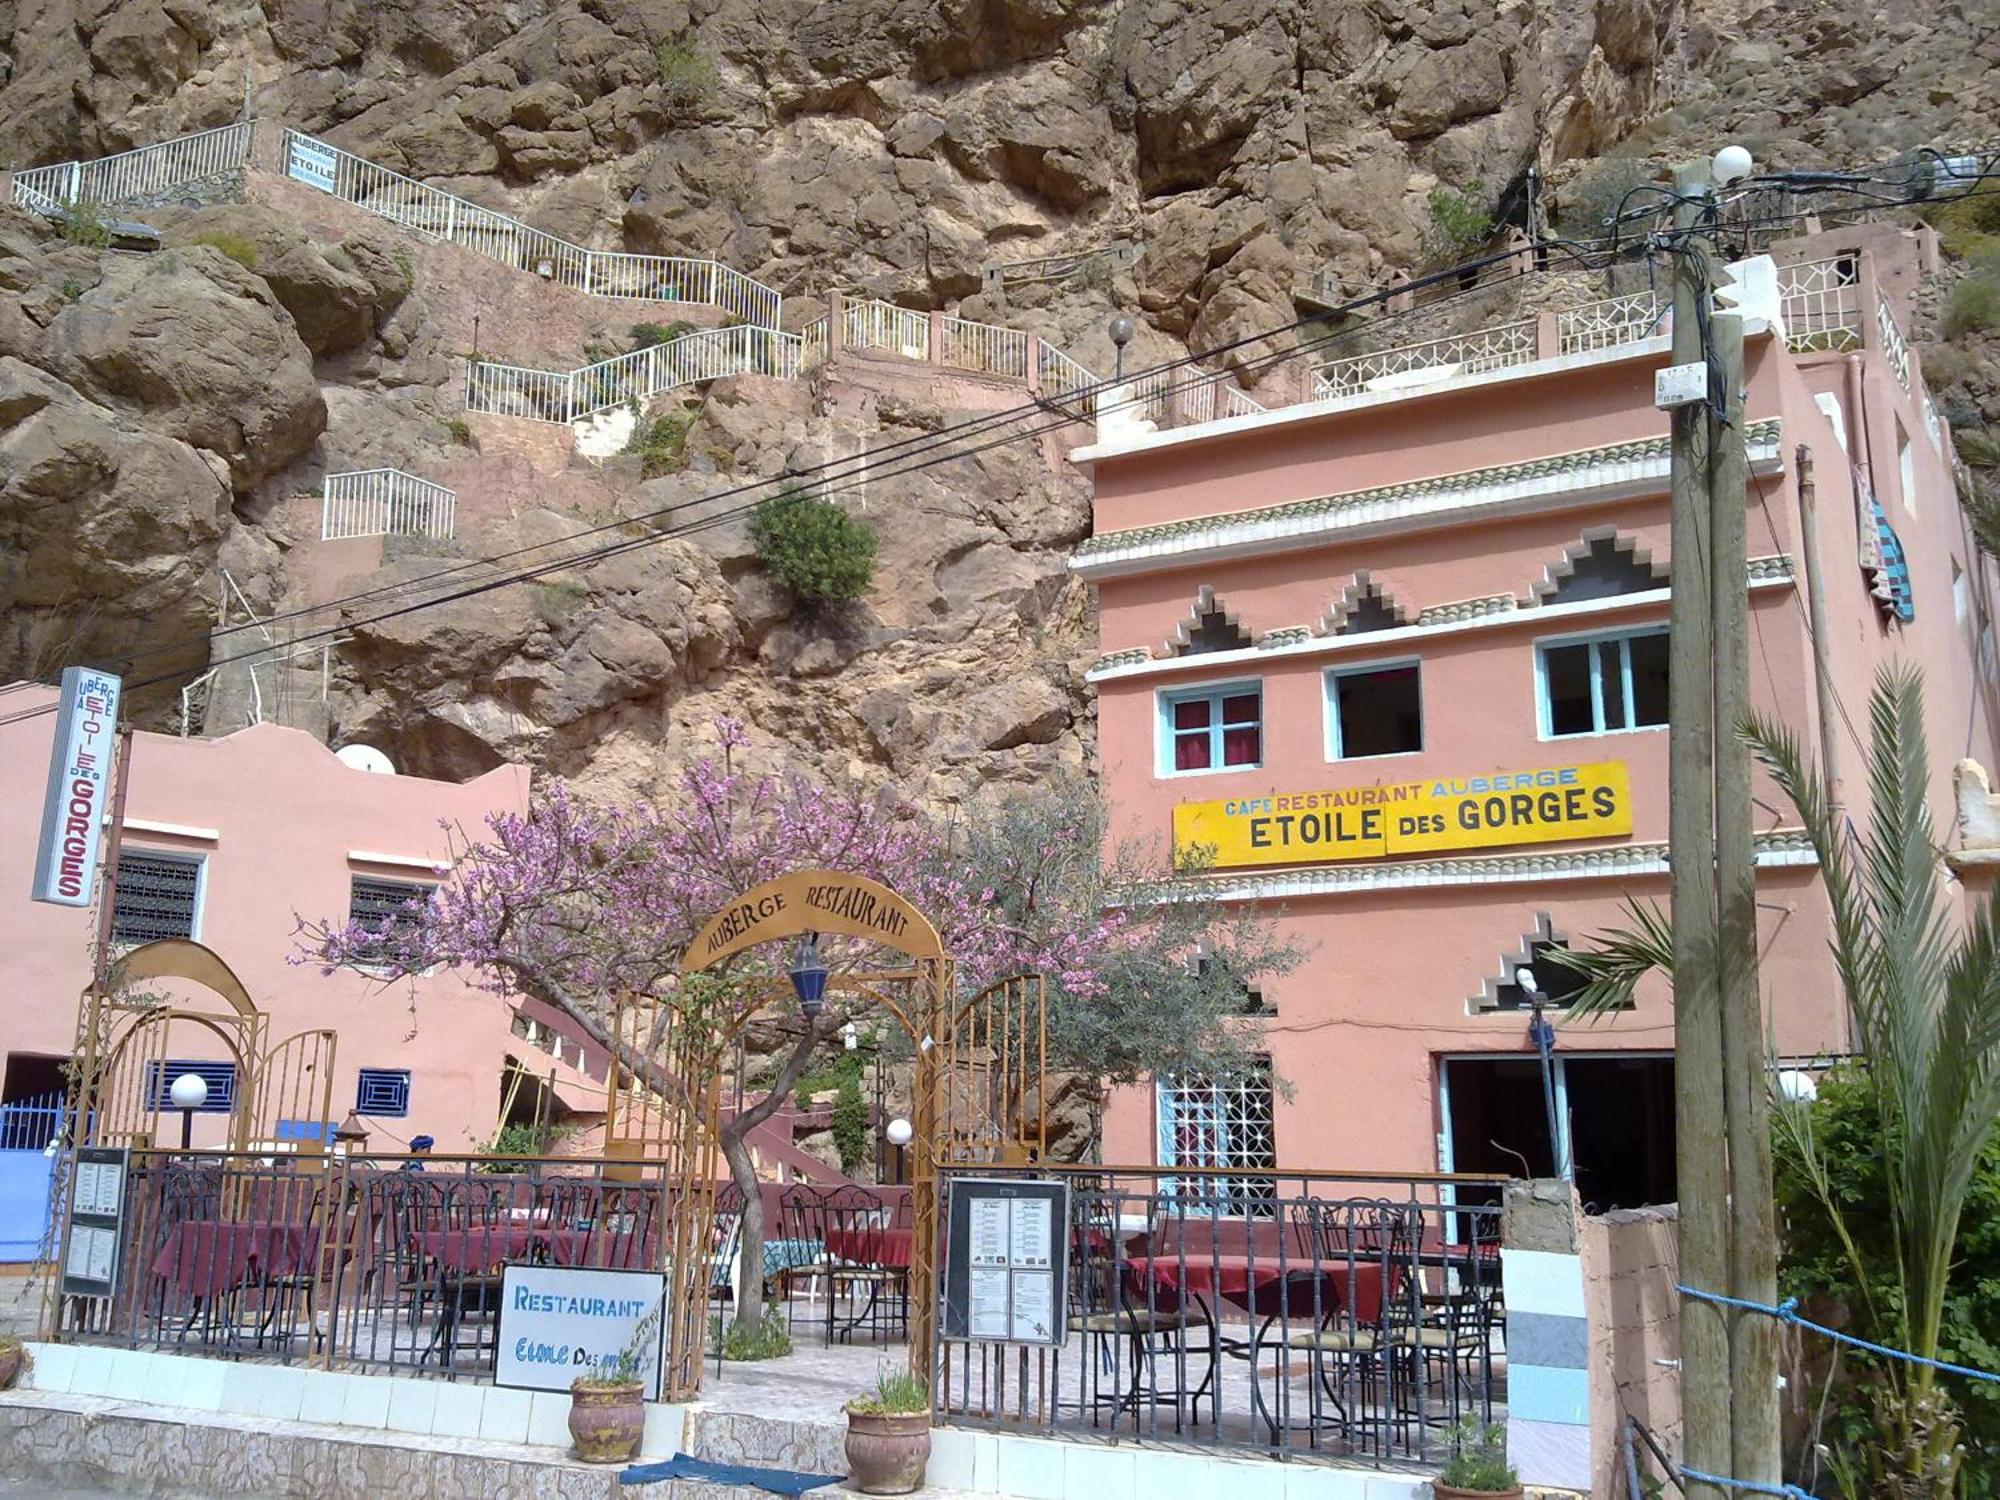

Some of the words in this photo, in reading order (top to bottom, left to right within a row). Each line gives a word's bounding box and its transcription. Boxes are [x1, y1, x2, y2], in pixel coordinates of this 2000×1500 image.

[291, 155, 335, 180] ETOILE
[292, 134, 337, 158] AUBERGE
[76, 695, 104, 772] ETOILE
[1277, 785, 1422, 811] RESTAURANT
[1431, 768, 1579, 798] AUBERGE
[58, 779, 94, 897] GORGES
[1250, 809, 1382, 848] ETOILE
[1399, 814, 1445, 836] DES
[1457, 786, 1616, 831] GORGES
[707, 892, 788, 954] AUBERGE
[806, 886, 909, 937] RESTAURANT
[513, 1285, 645, 1318] RESTAURANT
